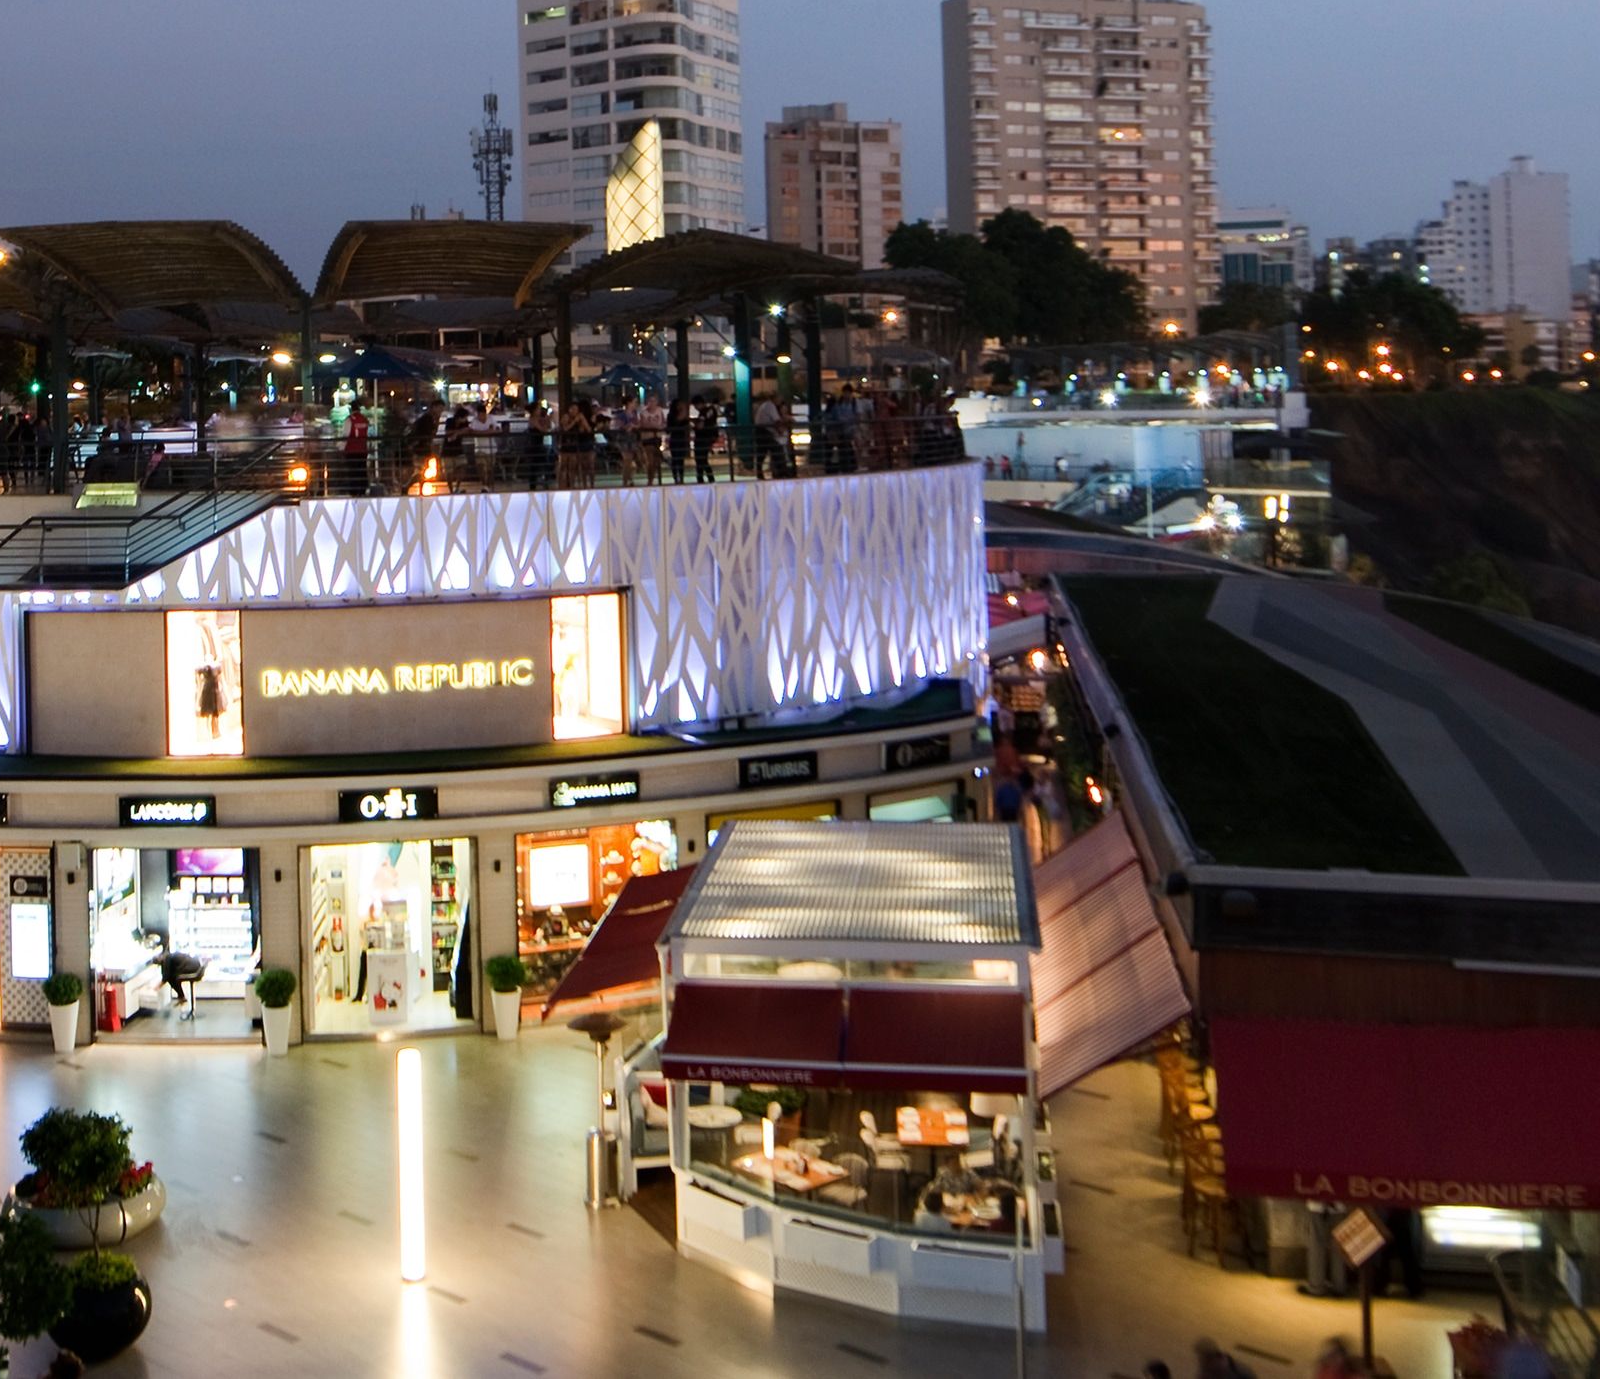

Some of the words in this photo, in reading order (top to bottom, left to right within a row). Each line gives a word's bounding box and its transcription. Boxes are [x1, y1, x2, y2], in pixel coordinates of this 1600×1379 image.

[261, 666, 389, 697] BANANA
[394, 658, 535, 692] REPUBLIC
[687, 1065, 706, 1078] LA
[710, 1066, 814, 1083] BONBONNIERE
[1293, 1173, 1335, 1195] LA
[1349, 1175, 1588, 1206] BONBONNIERE
